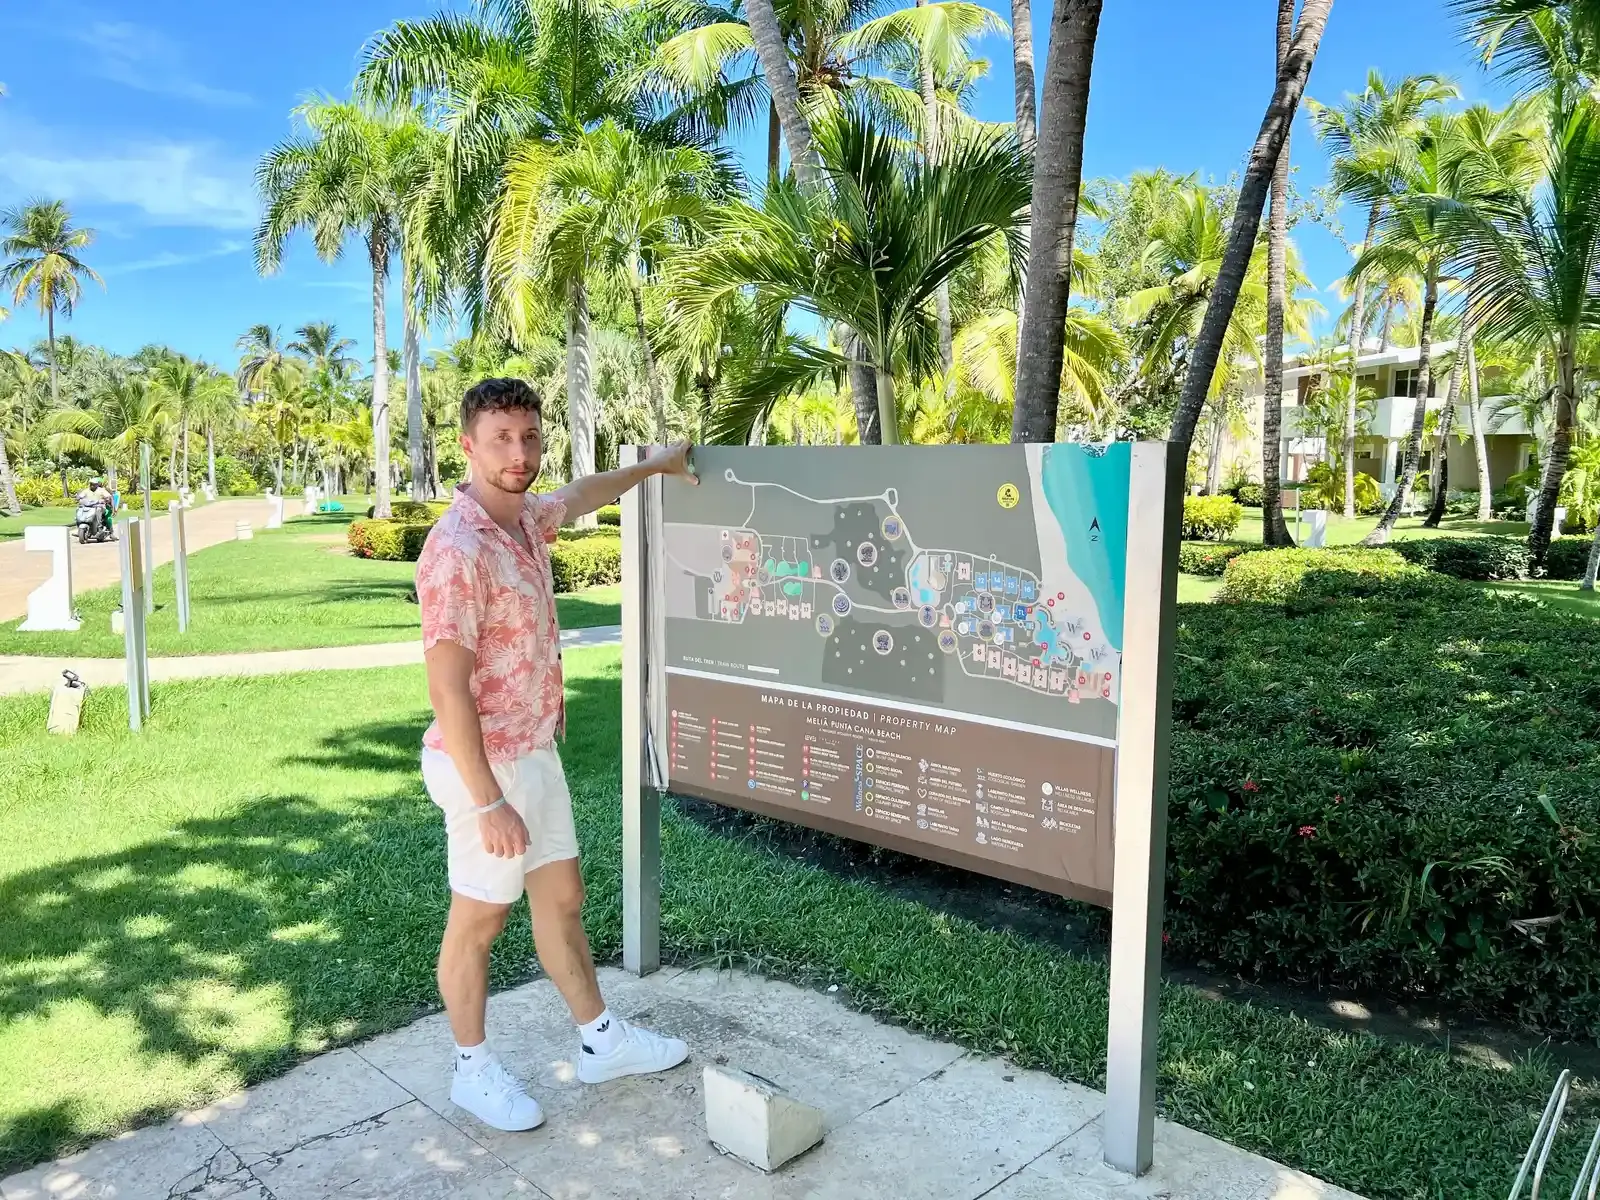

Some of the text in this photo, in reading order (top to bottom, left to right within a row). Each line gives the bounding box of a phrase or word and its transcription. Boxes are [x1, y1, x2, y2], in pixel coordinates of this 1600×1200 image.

[761, 694, 956, 735] MAPA DE LA PROPIEDAD PROPERTY MAP
[831, 720, 852, 730] PUNTA
[854, 725, 875, 735] CANA
[877, 729, 901, 740] BEACH
[1069, 788, 1092, 798] WELLNESS
[1073, 805, 1095, 815] DESCANSO
[1006, 823, 1028, 832] DESCANSO
[1059, 821, 1081, 830] BICICLETAS
